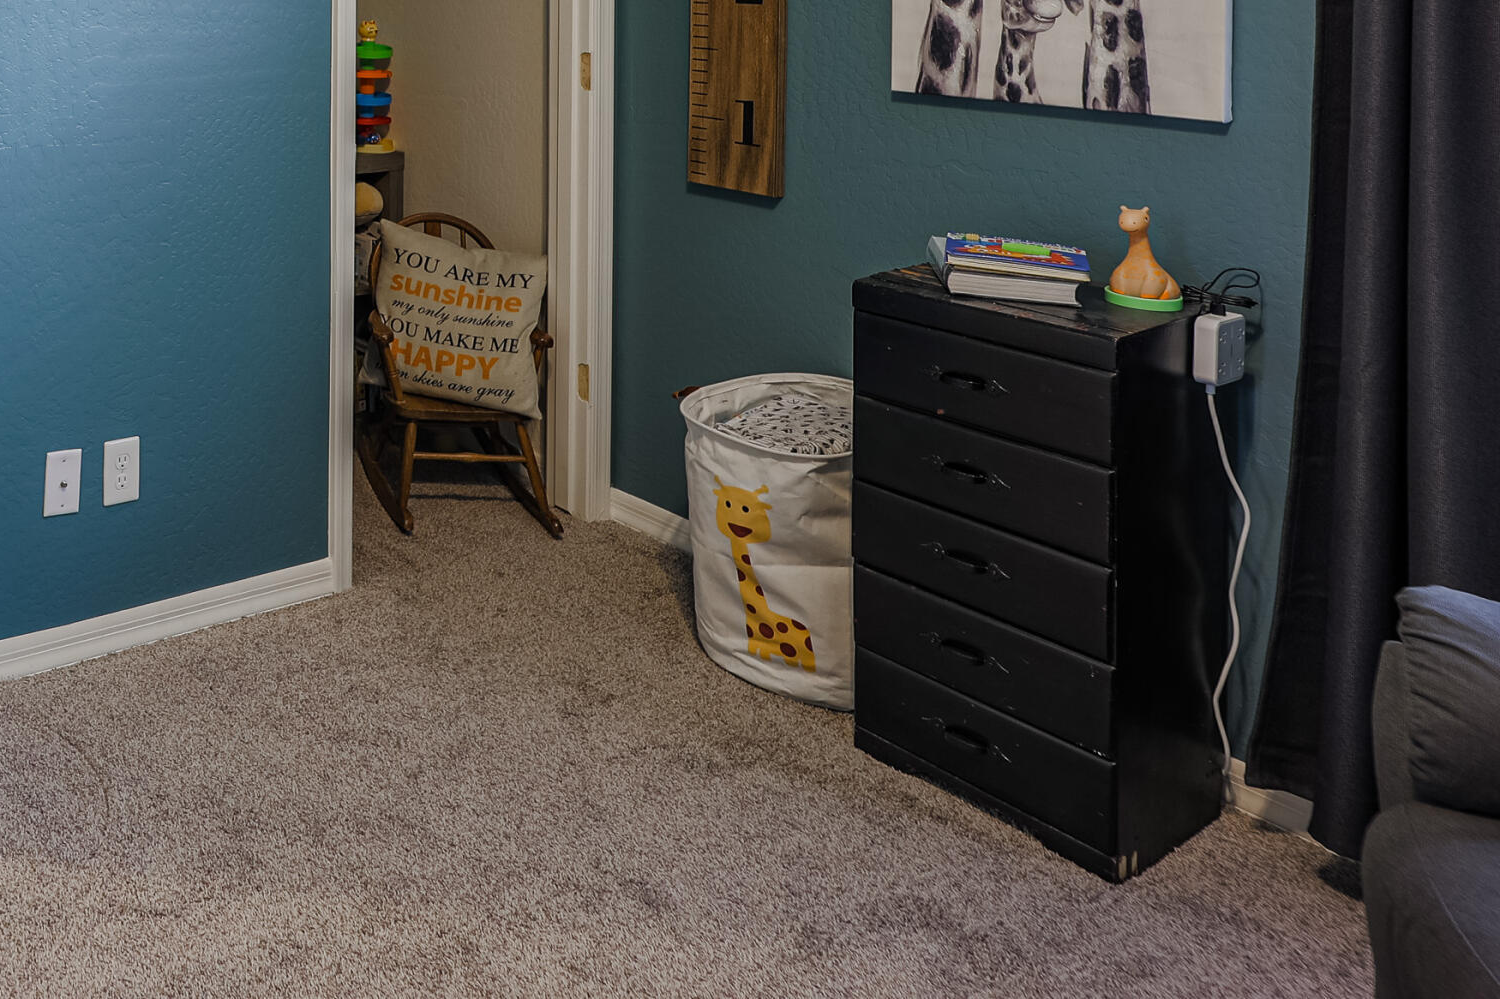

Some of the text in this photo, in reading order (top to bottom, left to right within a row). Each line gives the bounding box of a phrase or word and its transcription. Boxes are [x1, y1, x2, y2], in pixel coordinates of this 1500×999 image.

[734, 100, 762, 148] 1
[394, 247, 535, 290] YOU ARE MY
[389, 274, 523, 313] sunshine
[392, 299, 514, 328] my only sunshine
[391, 338, 500, 380] HAPPY
[423, 326, 485, 351] MAKE
[489, 337, 520, 354] ME
[412, 370, 516, 404] skies are gray
